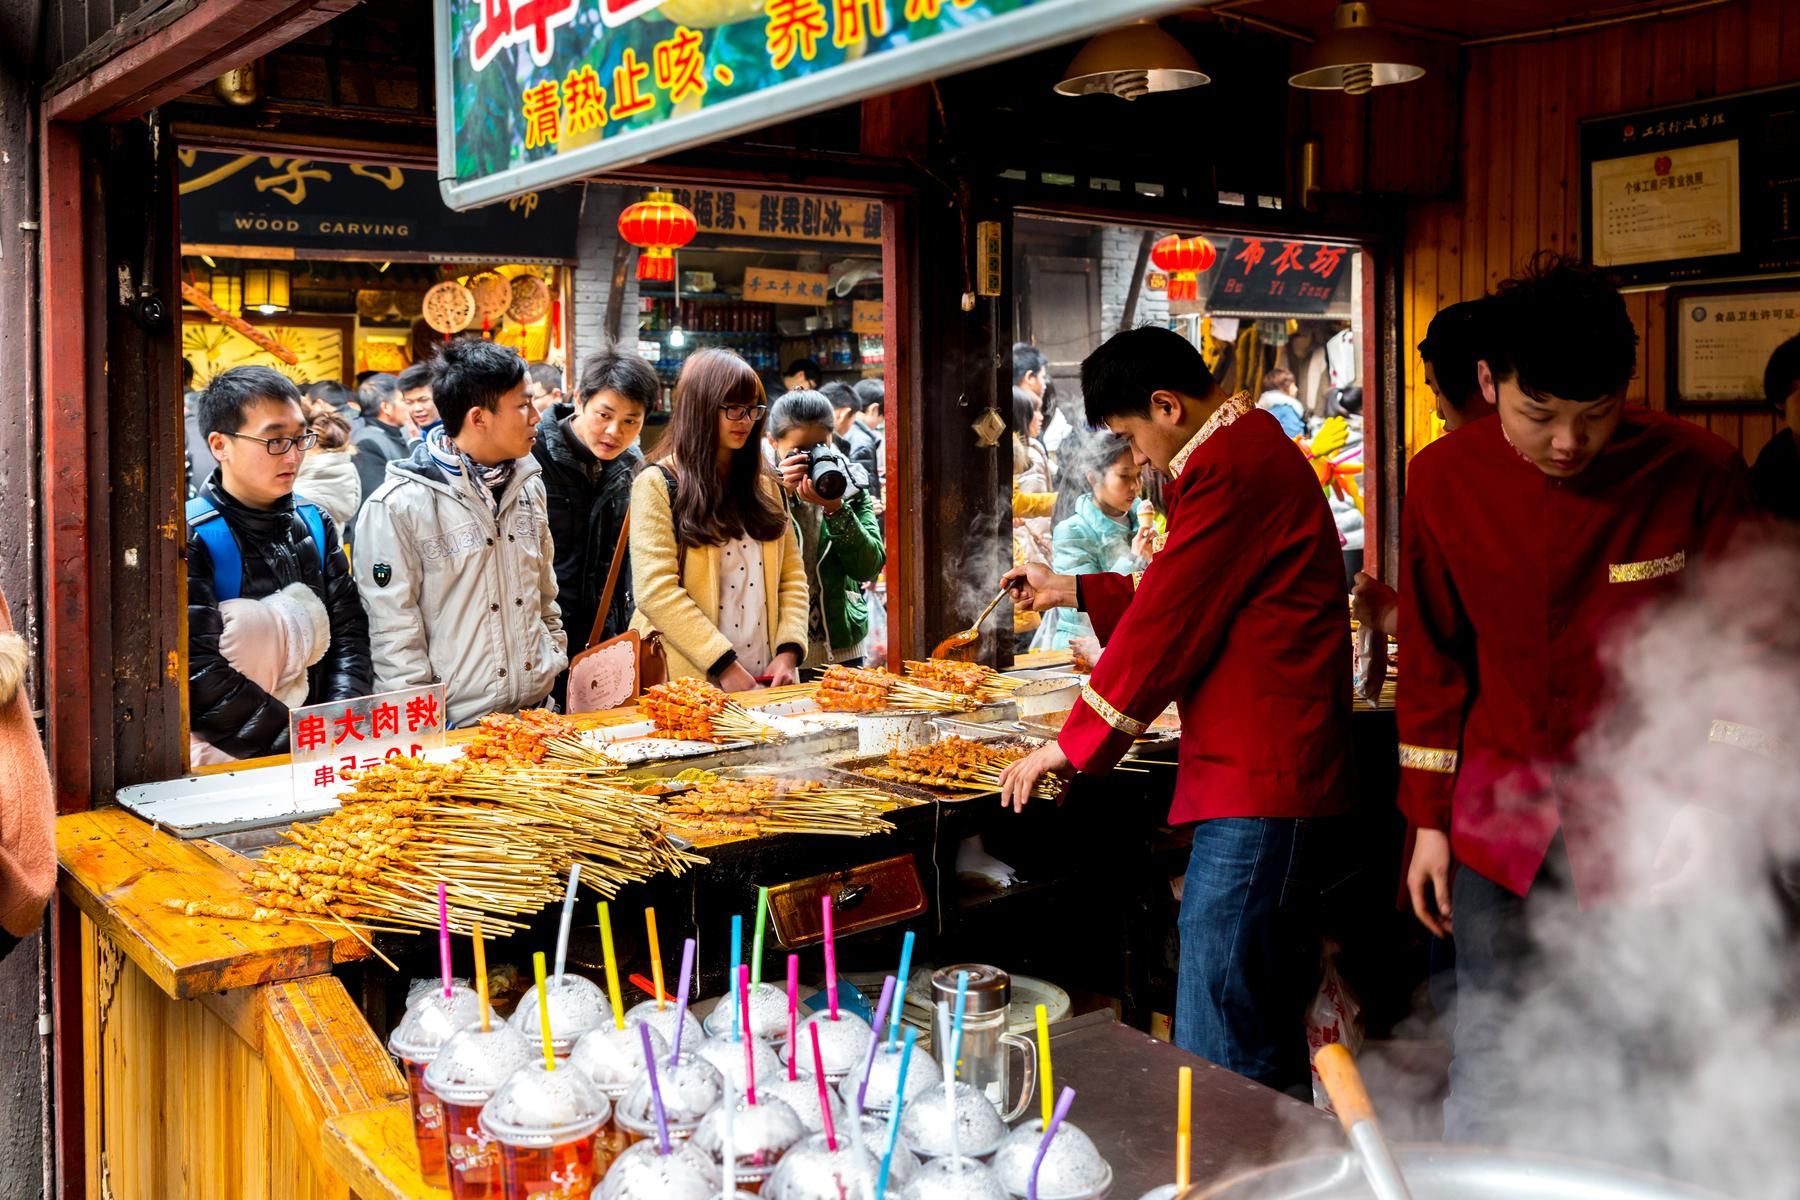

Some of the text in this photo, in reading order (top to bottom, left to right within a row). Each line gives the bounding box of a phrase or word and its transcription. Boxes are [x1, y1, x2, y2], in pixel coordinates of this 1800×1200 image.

[235, 218, 408, 236] WOOD CARVING
[1234, 238, 1348, 280] 布衣坊
